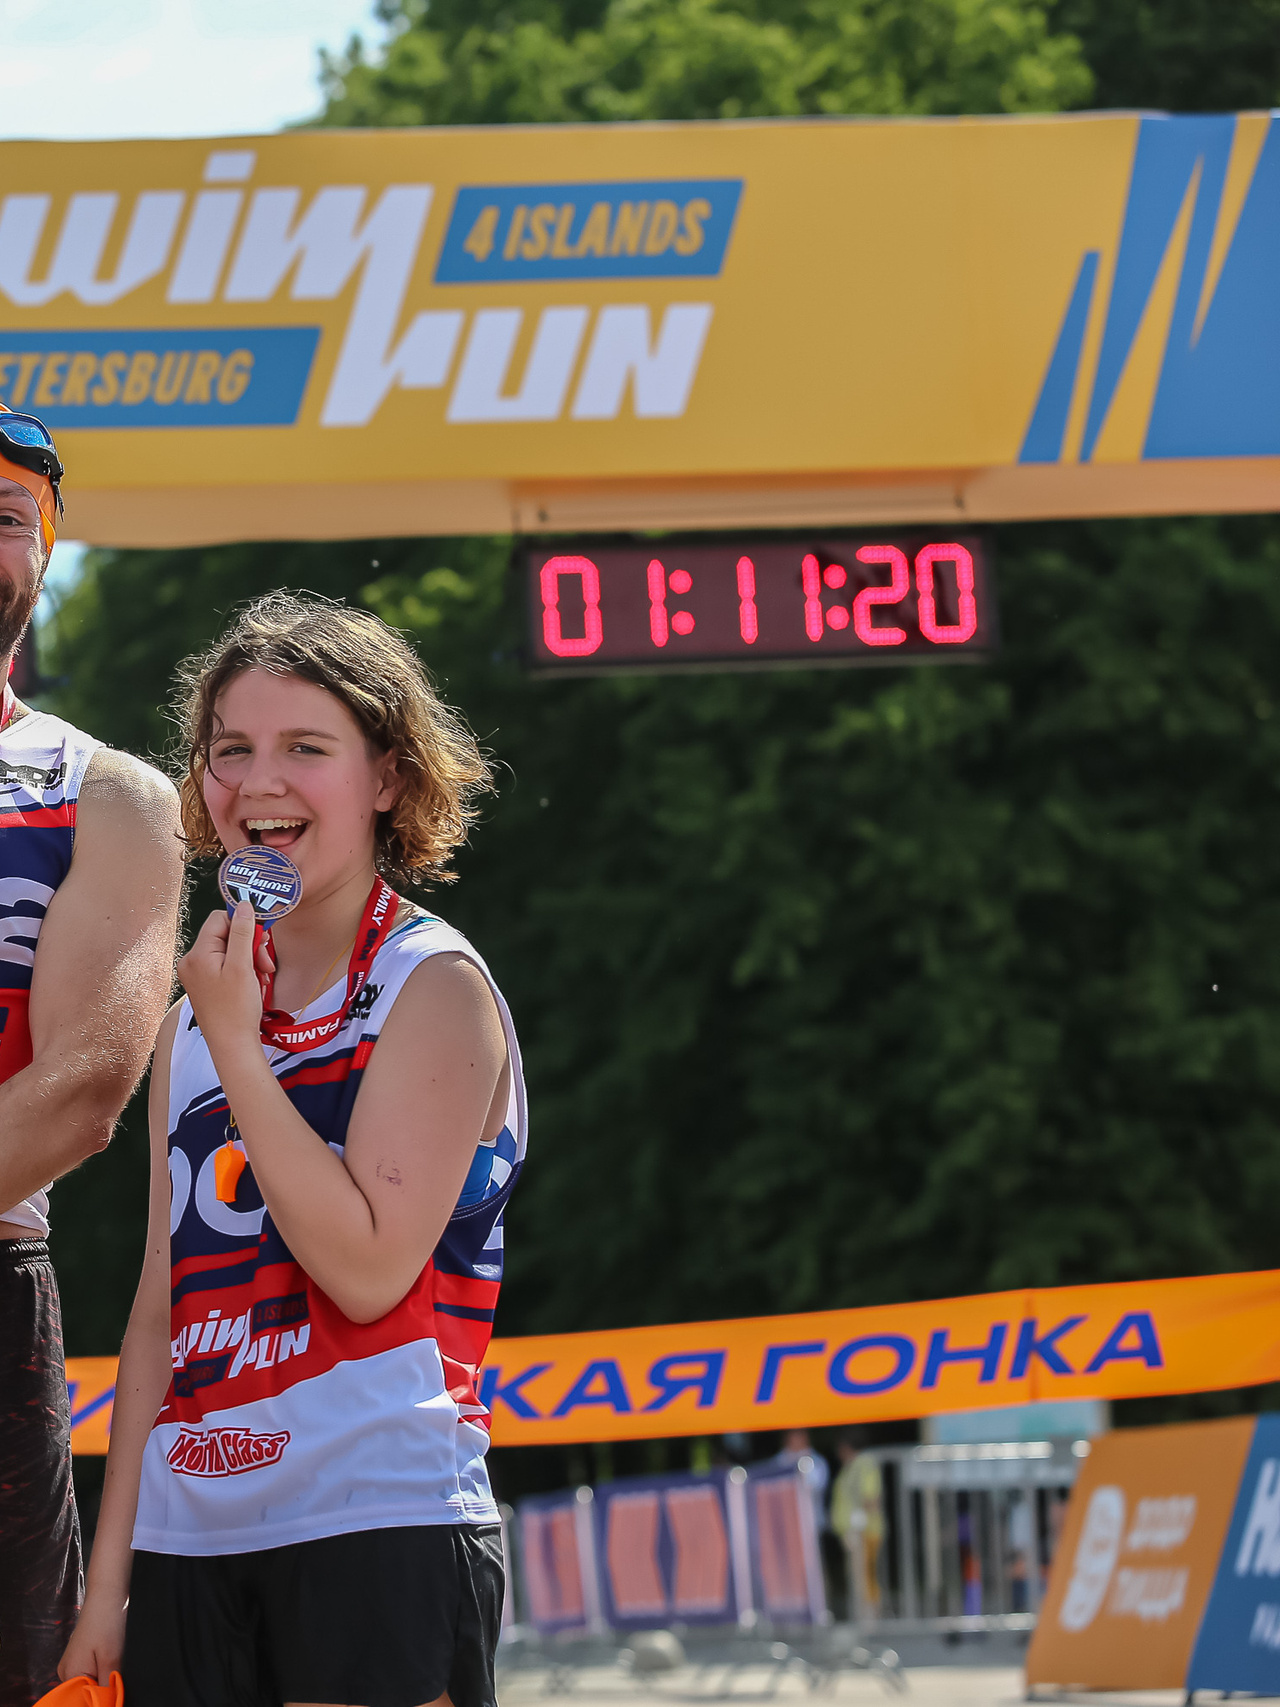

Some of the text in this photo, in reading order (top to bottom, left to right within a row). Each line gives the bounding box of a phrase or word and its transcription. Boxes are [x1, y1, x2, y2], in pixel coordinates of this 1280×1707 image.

[464, 199, 710, 261] 4 ISLANDS
[540, 543, 978, 657] 01:11:20
[272, 1017, 341, 1043] FAMILY
[478, 1310, 1167, 1421] КАЯ ГОНКА
